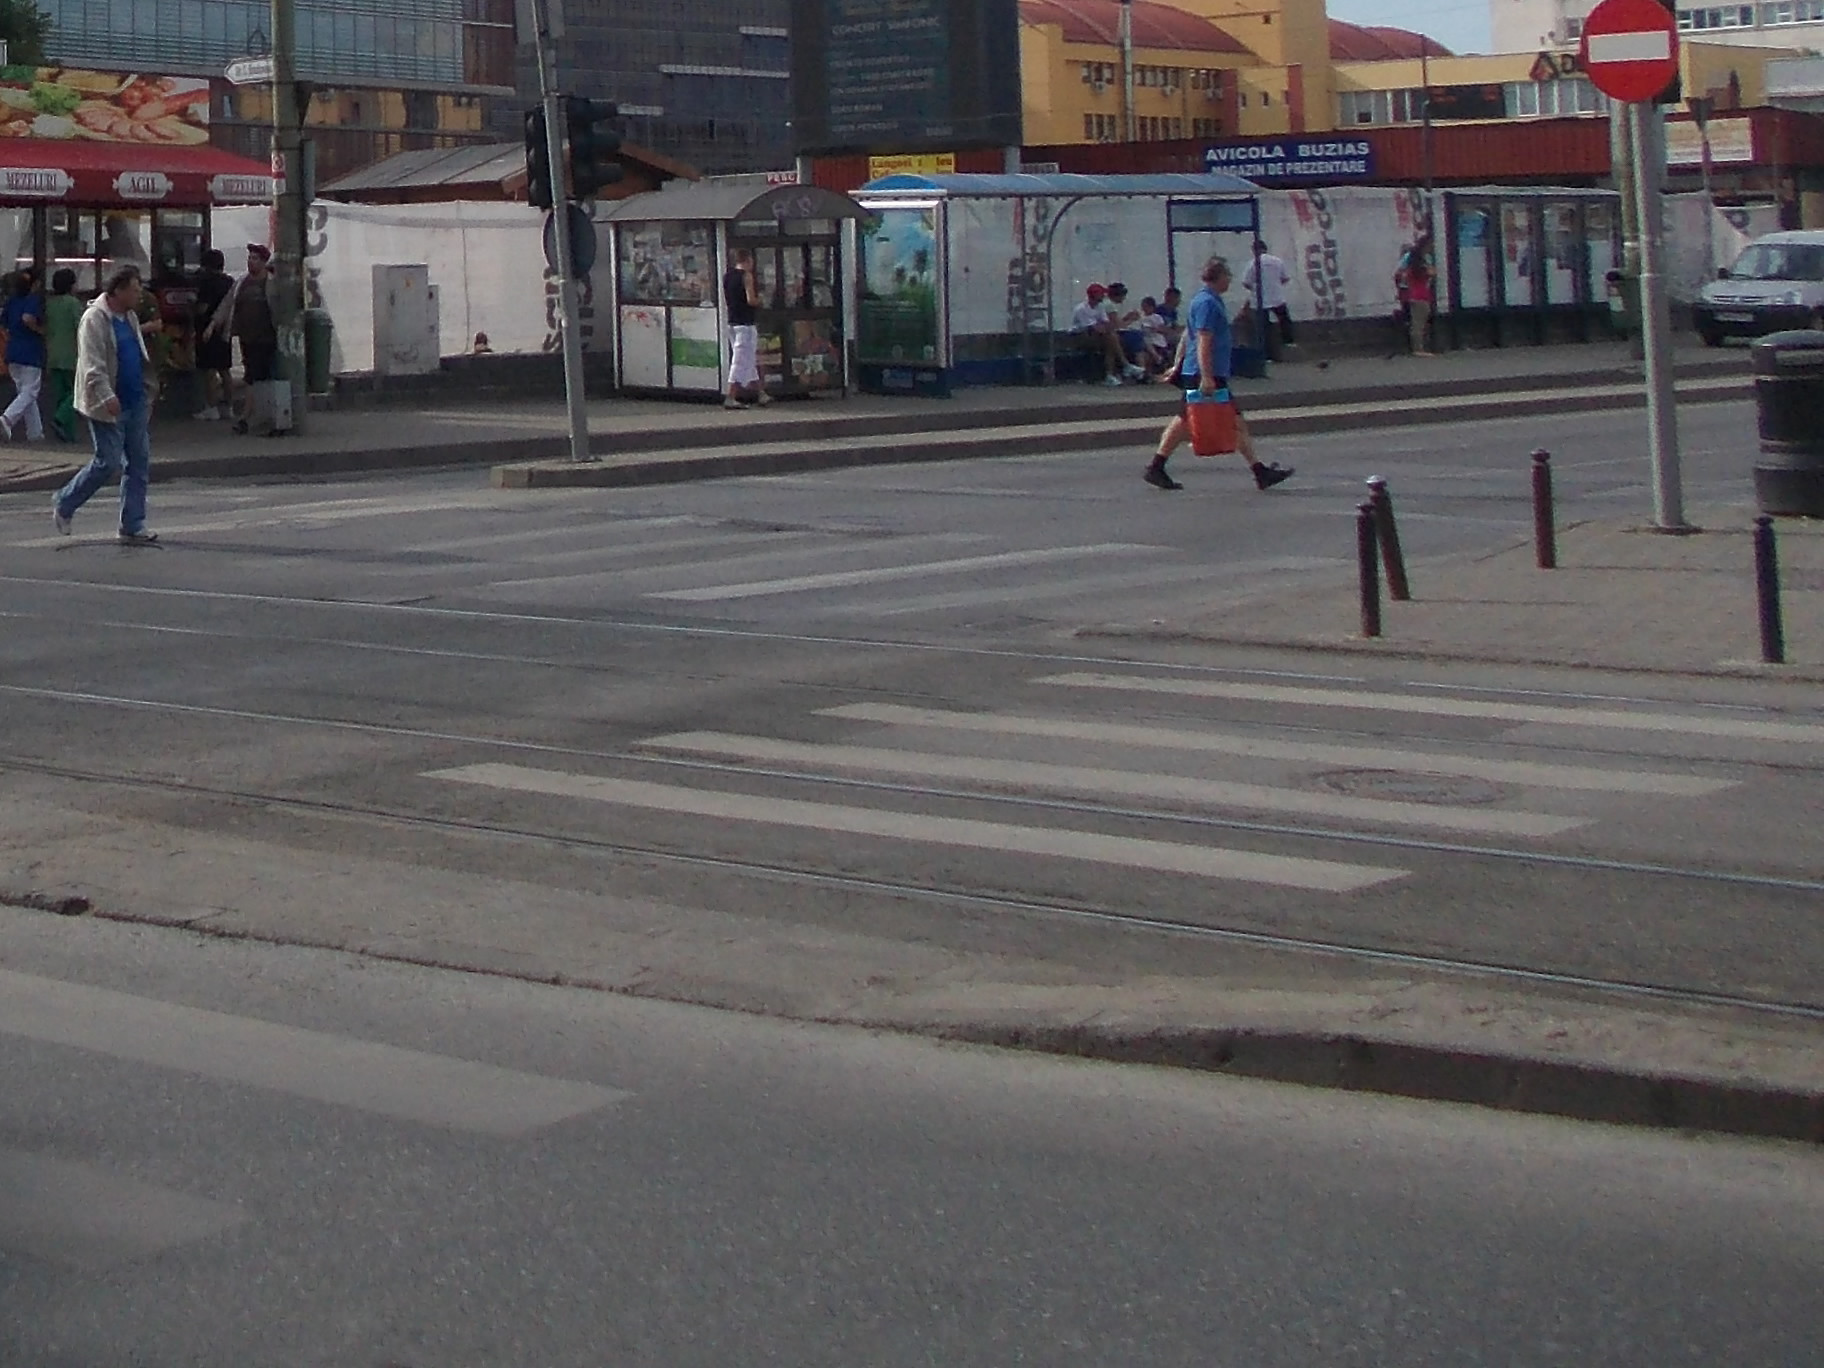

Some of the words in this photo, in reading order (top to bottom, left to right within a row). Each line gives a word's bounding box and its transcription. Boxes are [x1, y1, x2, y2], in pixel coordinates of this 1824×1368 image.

[1206, 145, 1285, 161] AVICOLA
[1298, 142, 1369, 157] BUZIAS
[1212, 163, 1264, 177] MAGAZIN
[1267, 163, 1284, 175] DE
[1286, 161, 1366, 175] PREZENTARE
[128, 177, 157, 194] AGIL
